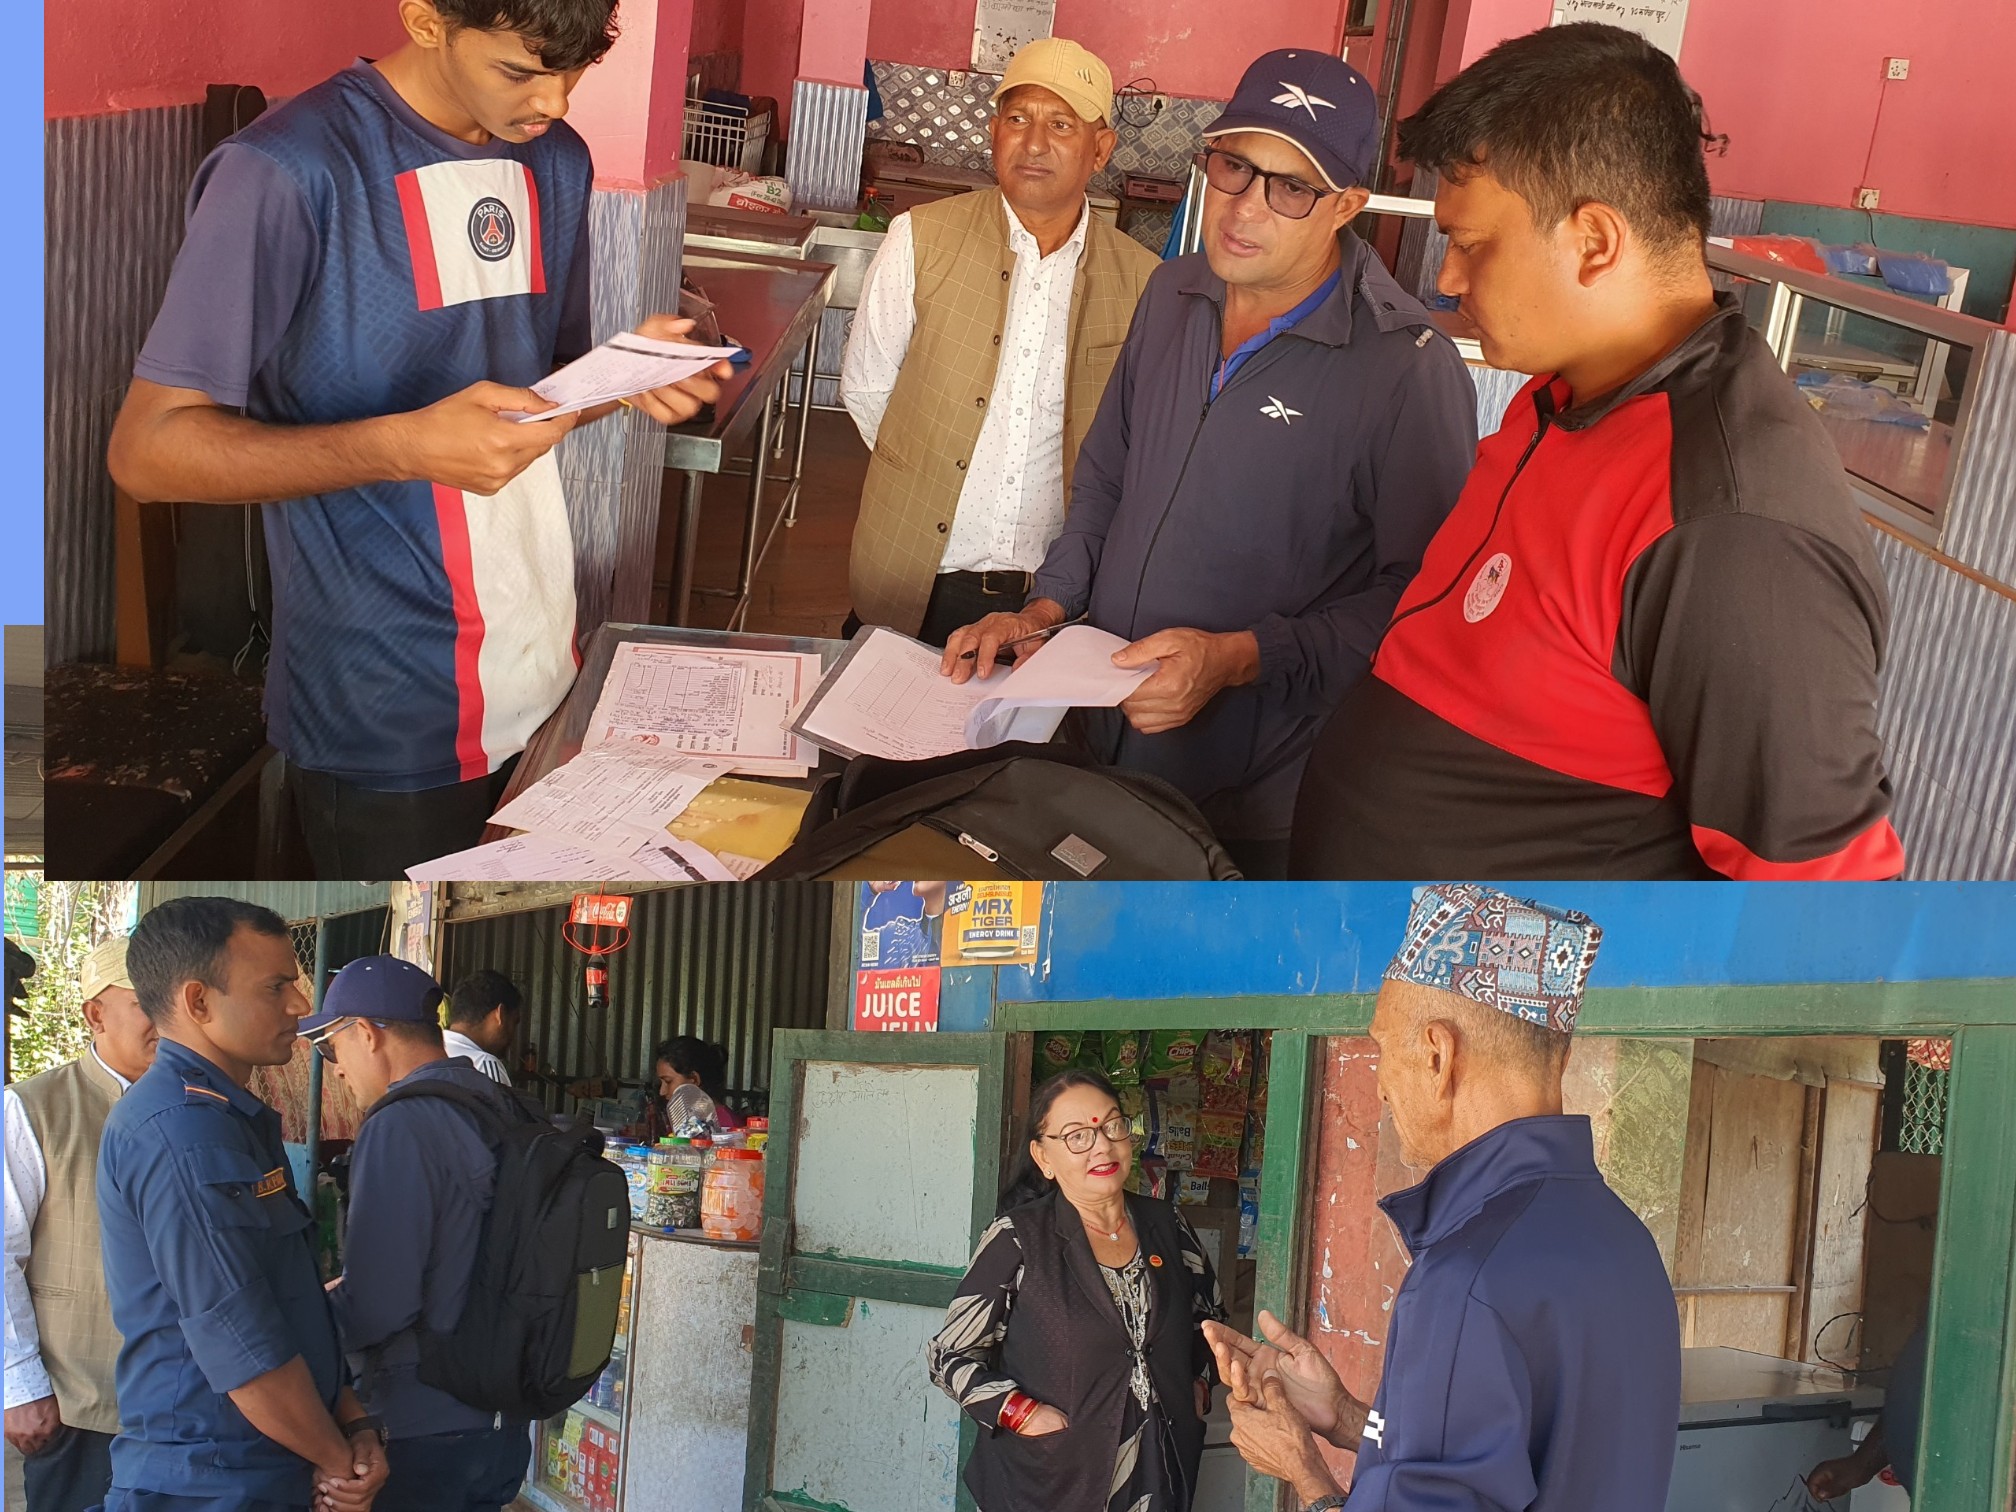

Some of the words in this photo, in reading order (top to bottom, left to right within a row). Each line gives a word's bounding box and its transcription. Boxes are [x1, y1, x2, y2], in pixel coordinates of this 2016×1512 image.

[766, 185, 782, 197] B2
[477, 204, 505, 219] PARIS
[973, 898, 1014, 916] MAX
[971, 916, 1013, 927] TIGER
[968, 930, 994, 939] ENERGY
[995, 930, 1014, 938] DRINK
[861, 991, 922, 1018] JUICE
[1168, 1046, 1195, 1057] Chips
[1168, 1126, 1191, 1137] Balls
